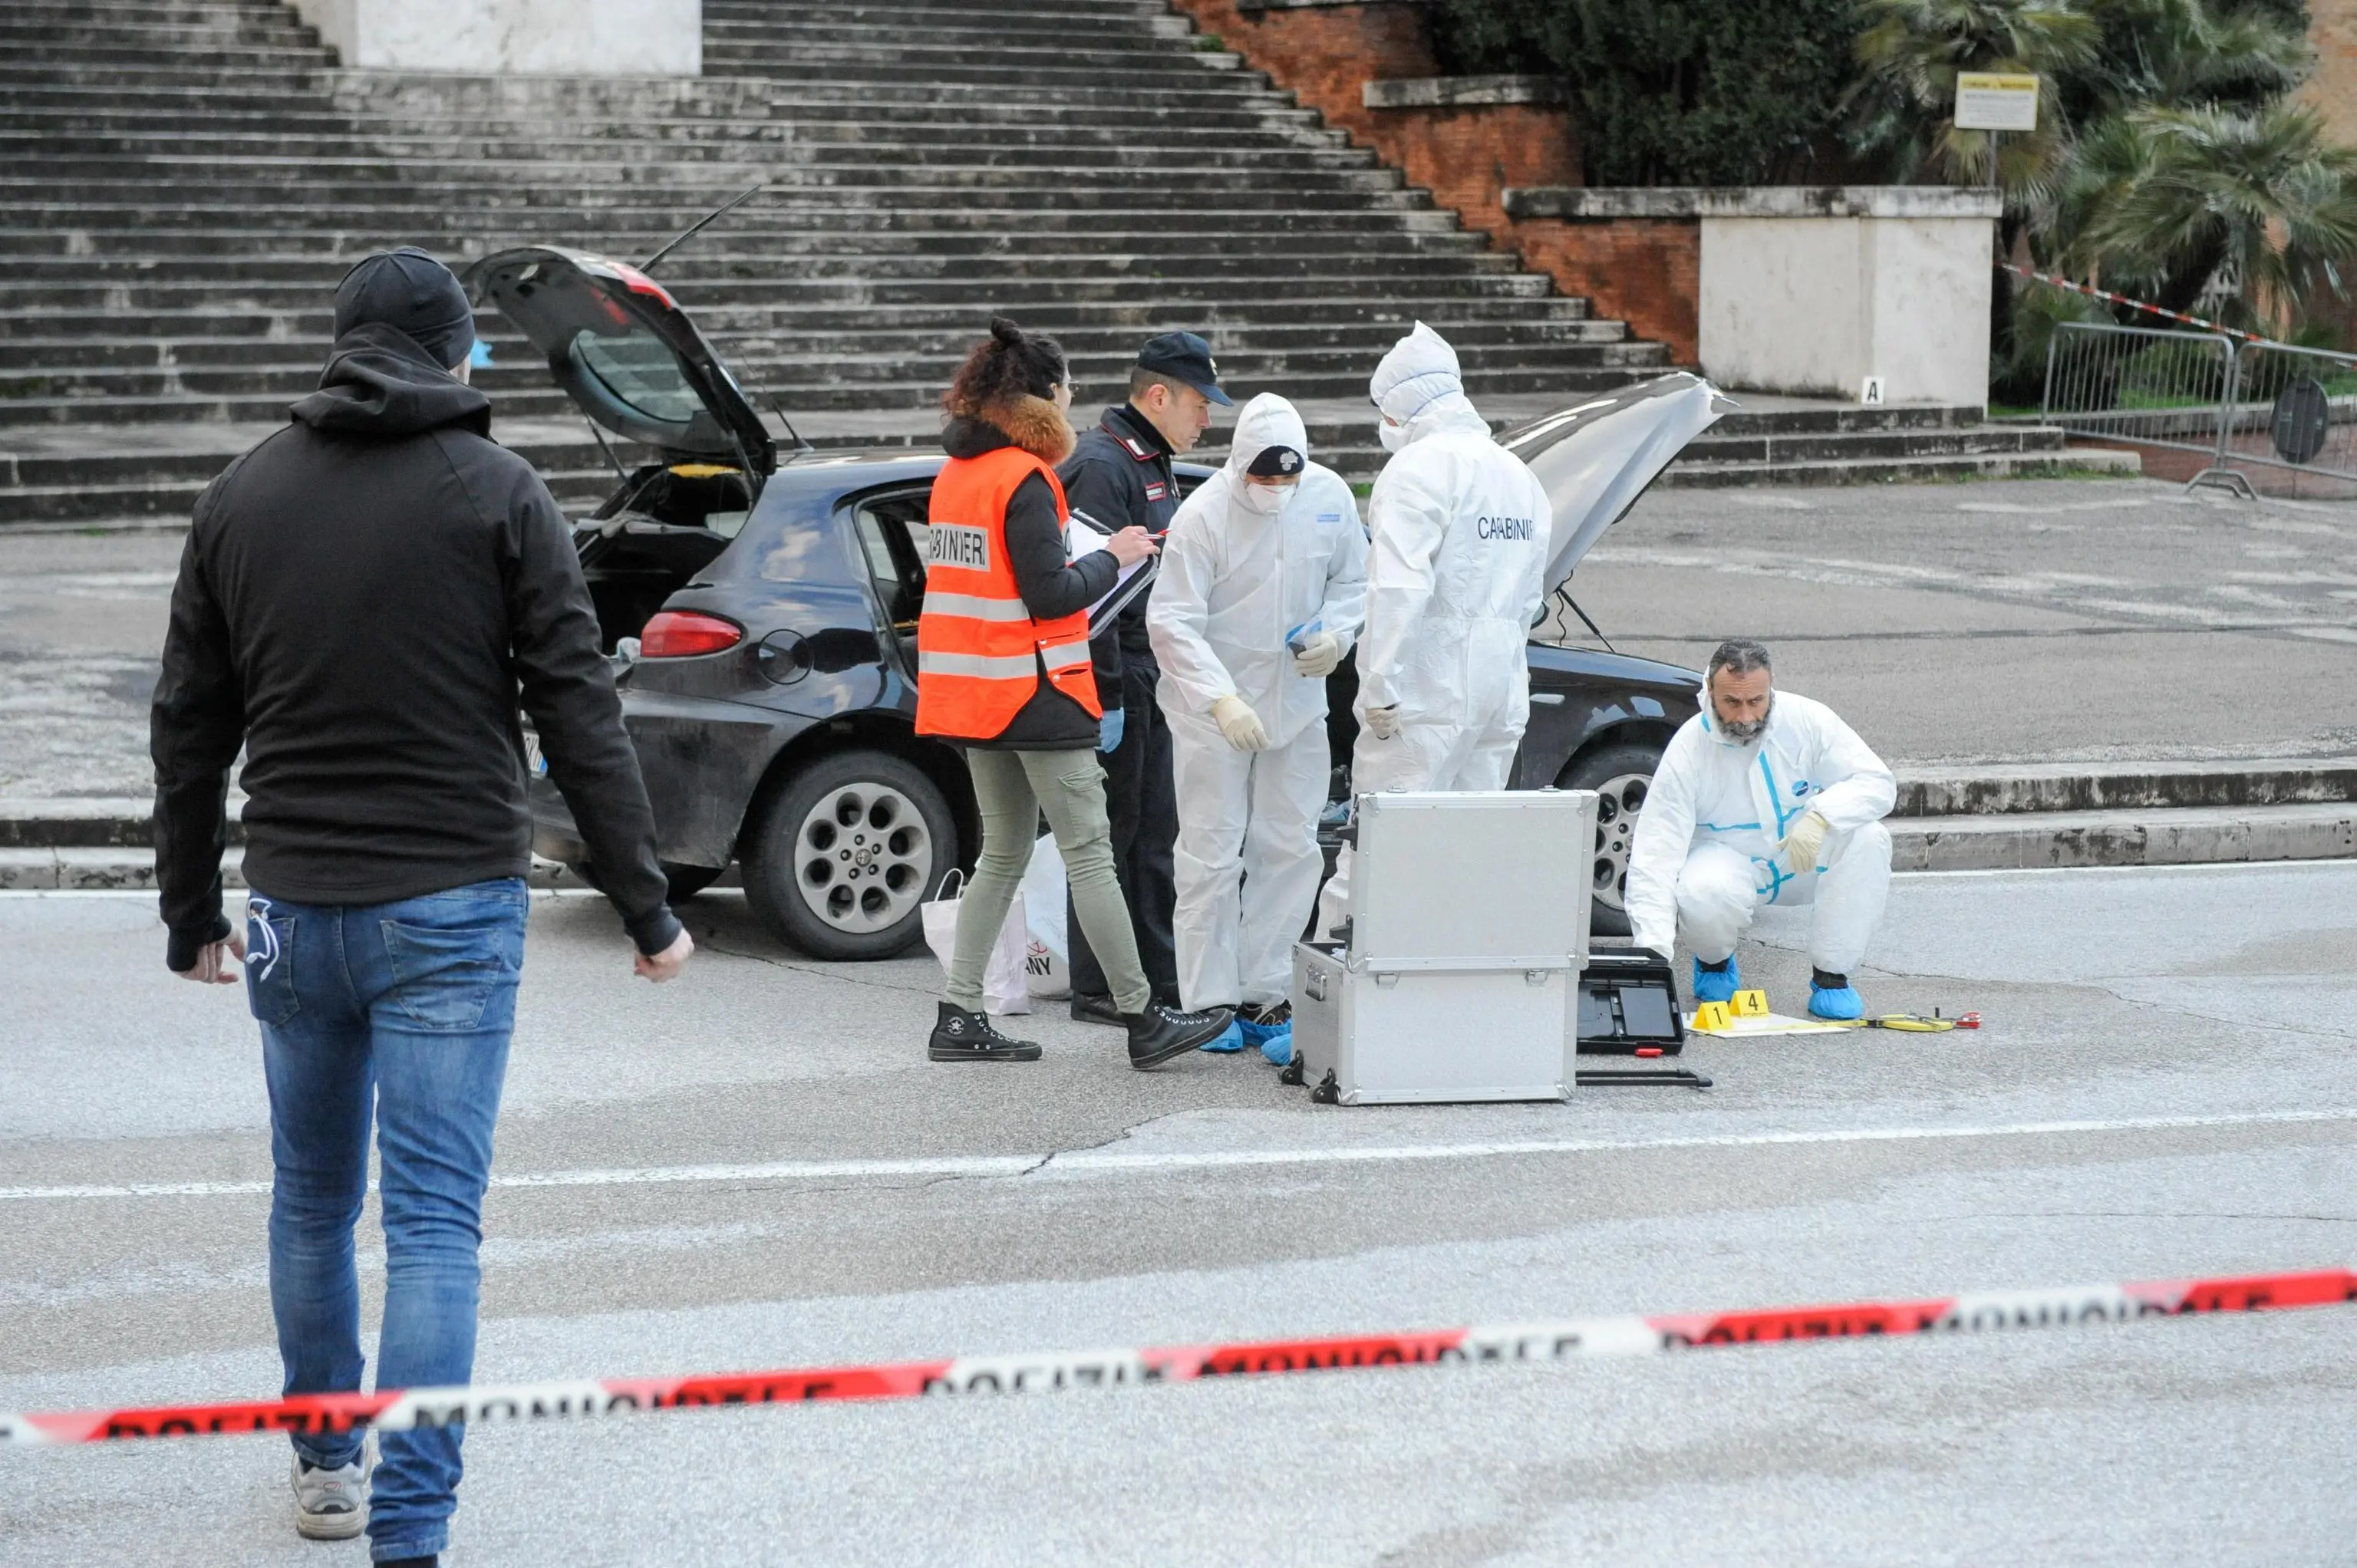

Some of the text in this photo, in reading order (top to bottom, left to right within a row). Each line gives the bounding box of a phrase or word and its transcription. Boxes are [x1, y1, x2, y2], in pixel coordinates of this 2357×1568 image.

[1867, 381, 1877, 400] A
[1748, 993, 1759, 1011] 4
[1713, 1006, 1722, 1025] 1
